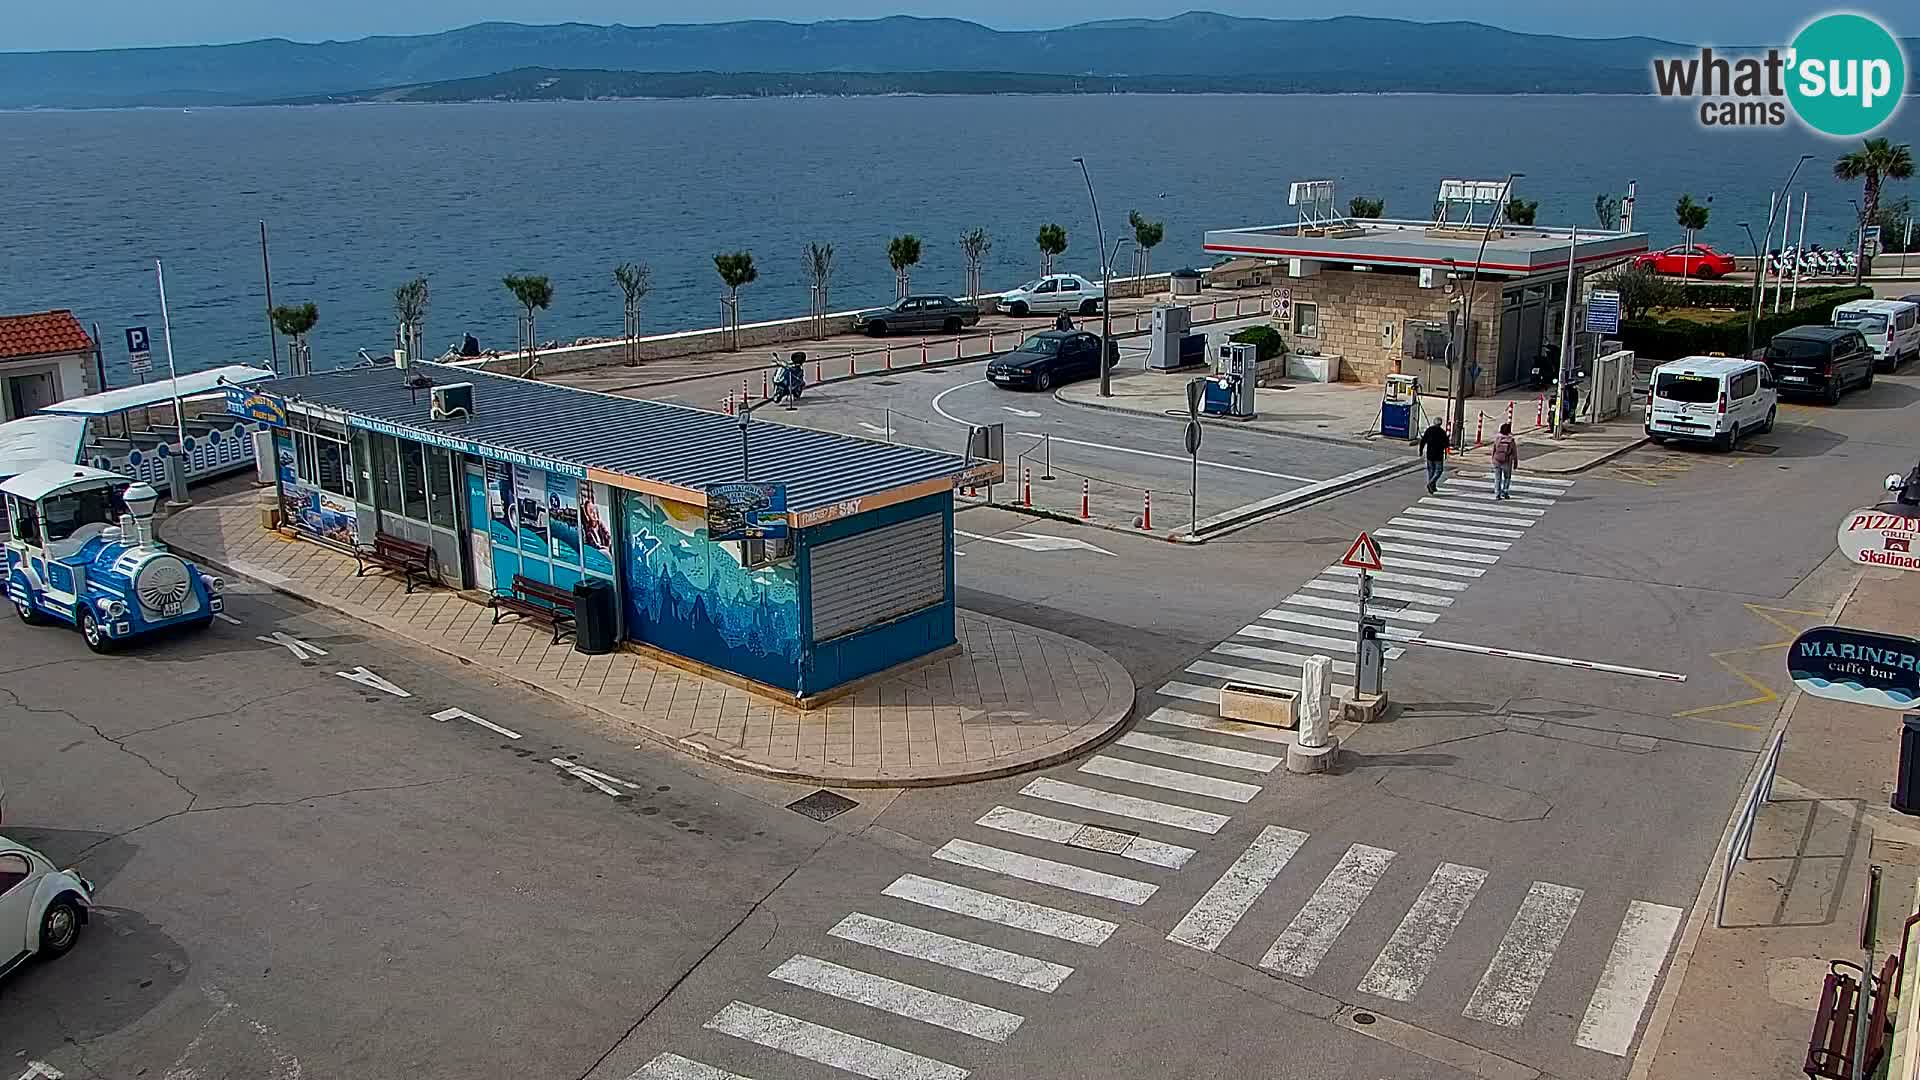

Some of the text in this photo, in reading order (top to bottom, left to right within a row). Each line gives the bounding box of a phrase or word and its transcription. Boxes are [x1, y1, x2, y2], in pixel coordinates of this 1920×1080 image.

[131, 330, 143, 349] P
[436, 436, 469, 452] POSTAJA
[479, 446, 494, 457] BUS
[494, 450, 527, 465] STATION
[528, 457, 555, 471] TICKET
[556, 463, 583, 477] OFFICE
[1848, 514, 1920, 533] PIZZE
[1881, 530, 1917, 541] GRILL
[1828, 661, 1897, 680] caffe bar
